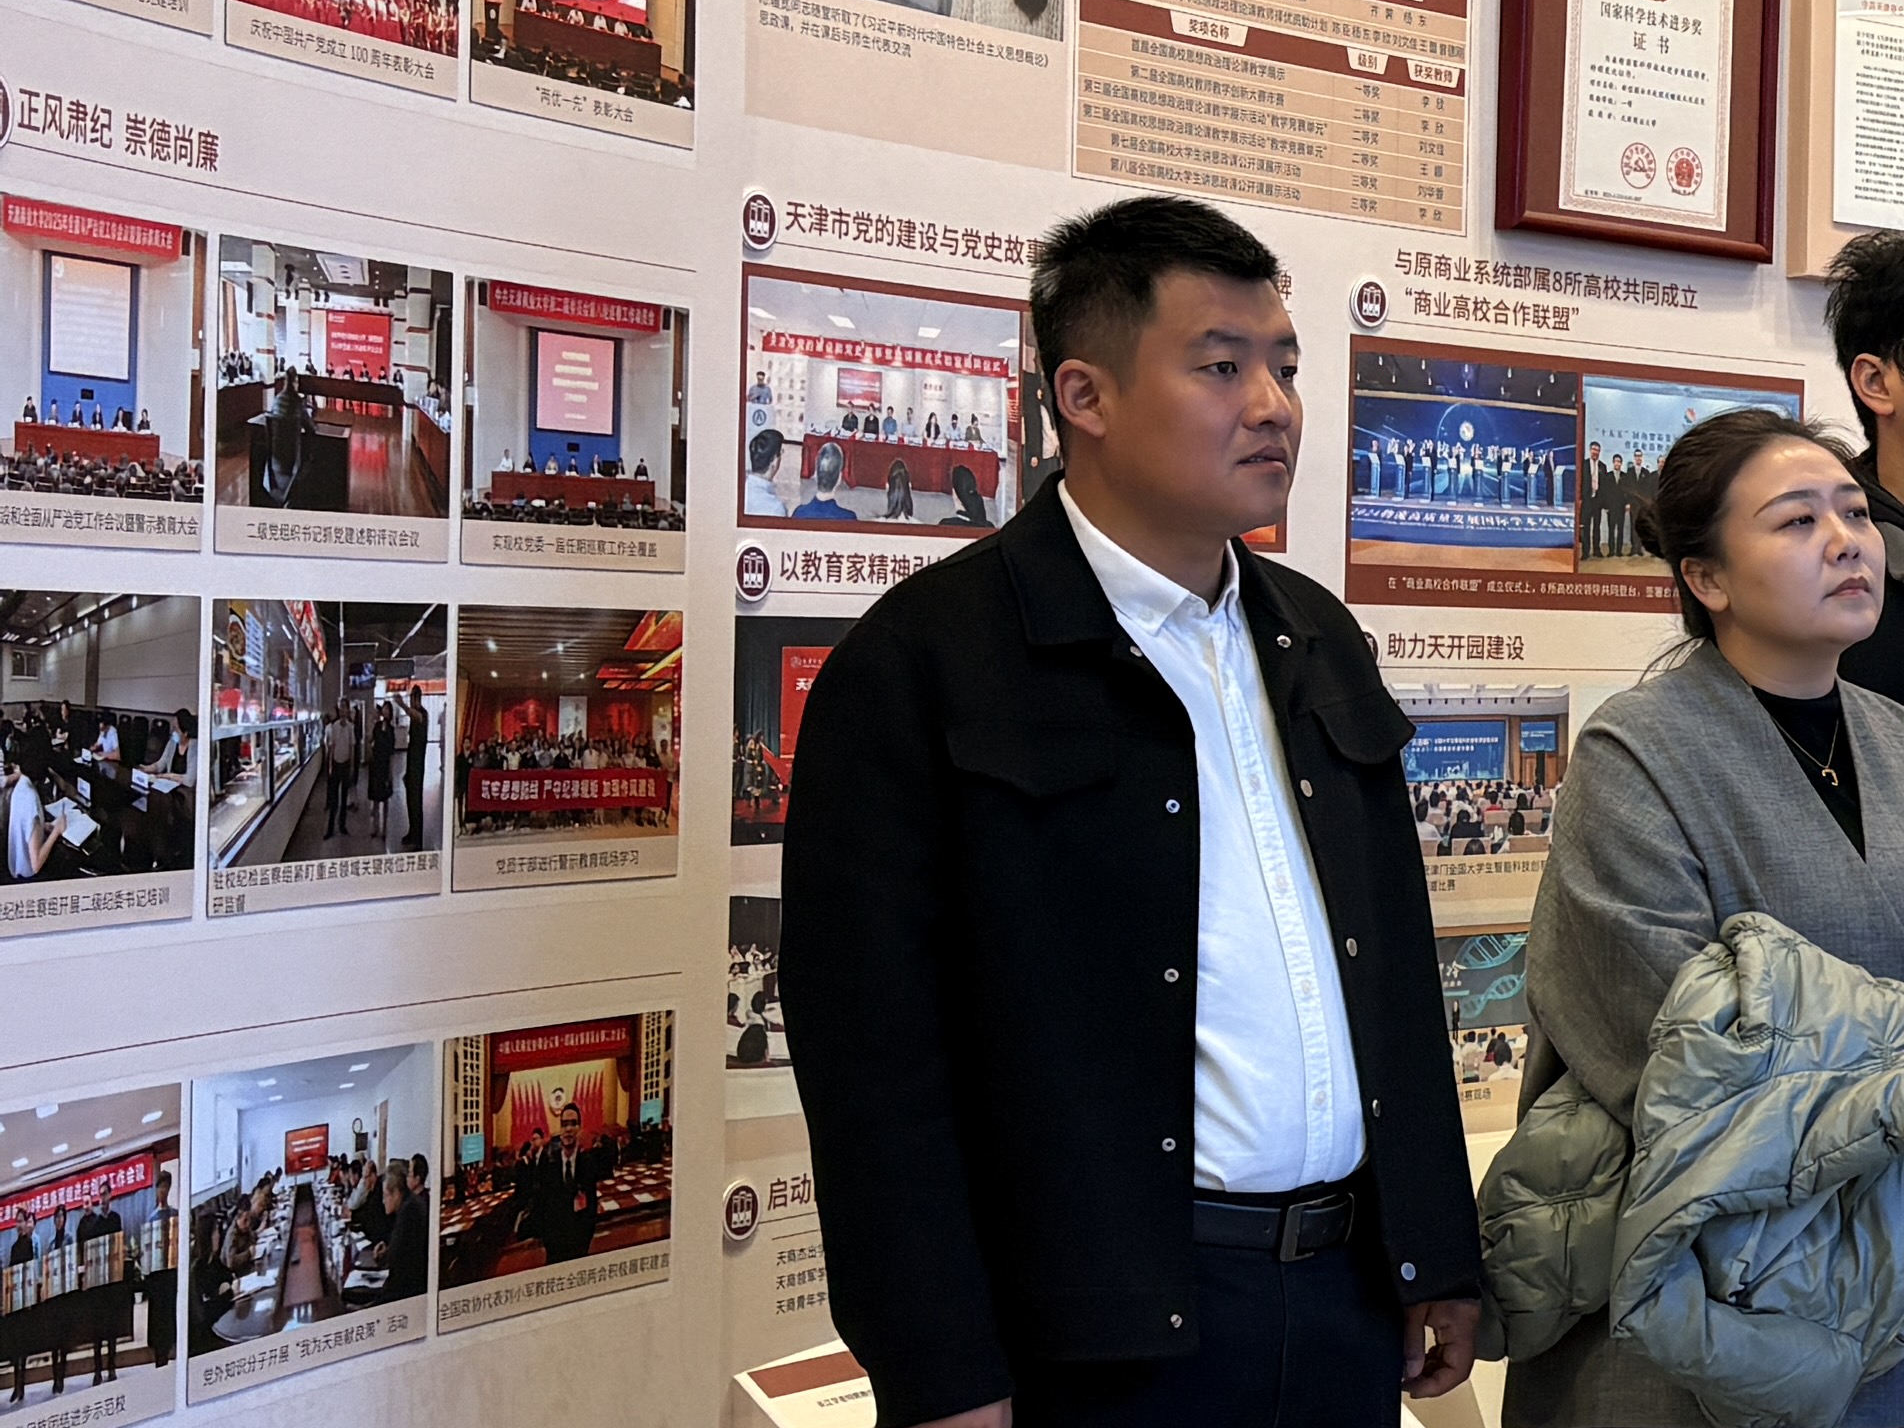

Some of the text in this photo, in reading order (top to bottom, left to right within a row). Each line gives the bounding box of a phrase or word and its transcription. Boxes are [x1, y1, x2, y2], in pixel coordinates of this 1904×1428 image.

[1600, 1, 1702, 36] 国家科学技术进步奖
[351, 45, 368, 63] 100
[1189, 19, 1229, 39] 奖项名称
[1414, 64, 1453, 83] 获奖教师
[17, 89, 219, 172] 正风肃纪 崇德尚廉
[1395, 249, 1698, 309] 与原商业系统部属8所高校共同成立
[1405, 287, 1580, 331] “商业高校合作联盟”
[780, 551, 942, 584] 以教育家精神
[1388, 577, 1397, 589] 在
[1388, 633, 1525, 662] 助力天开园建设
[768, 1173, 811, 1211] 启动
